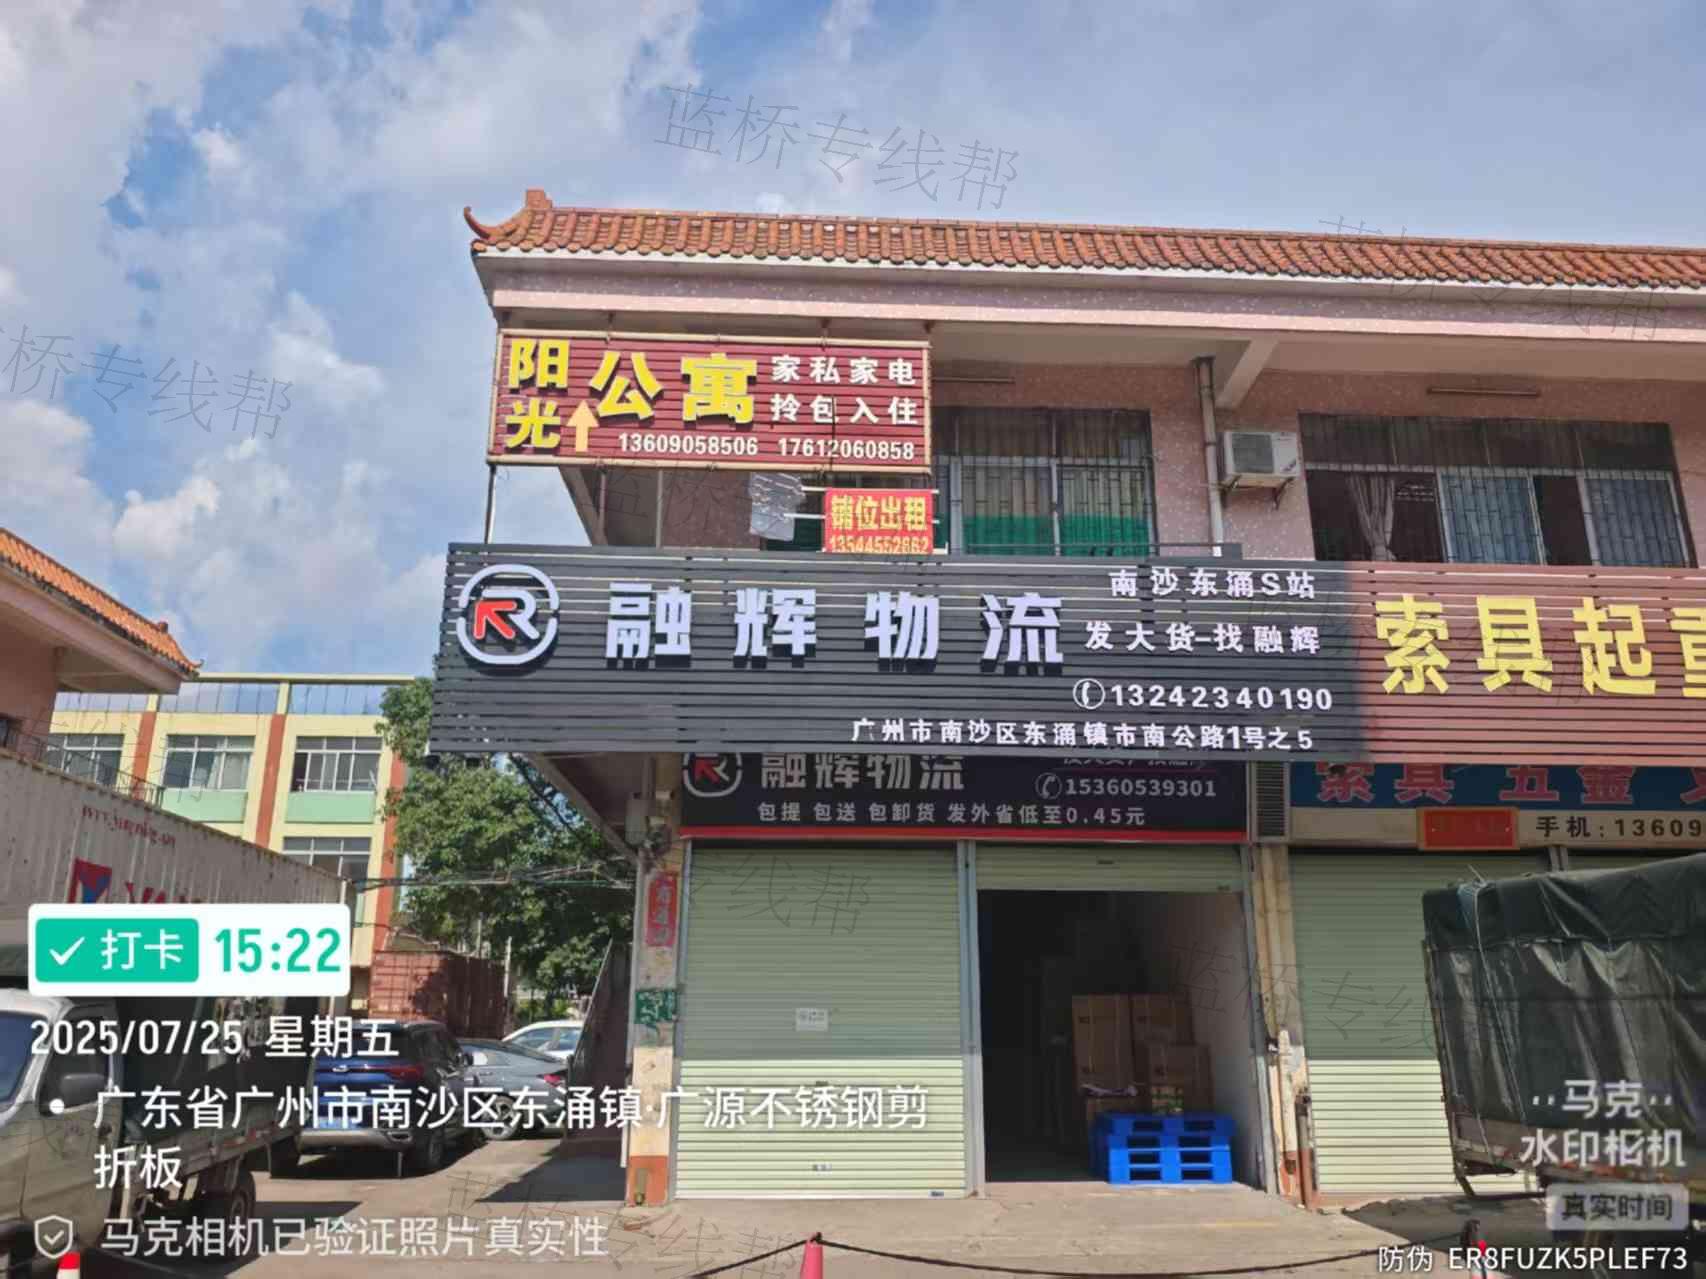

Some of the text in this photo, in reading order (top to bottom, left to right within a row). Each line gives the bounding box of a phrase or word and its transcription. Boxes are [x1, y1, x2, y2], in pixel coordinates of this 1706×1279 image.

[771, 355, 918, 386] 家私家电
[770, 394, 918, 425] 拎包入住
[618, 431, 915, 461] 13609058506 17612060858
[1109, 568, 1316, 600] 南沙东涌S站
[606, 582, 1063, 664] 融辉物流
[1110, 684, 1333, 711] 13242340190
[851, 717, 1314, 751] 广州市南沙区东涌镇市南公路1号之5
[761, 752, 965, 790] 融辉物流
[1065, 777, 1217, 798] 15360539301
[757, 802, 1146, 826] 包提 包送 包卸货 发外省低至0.45元
